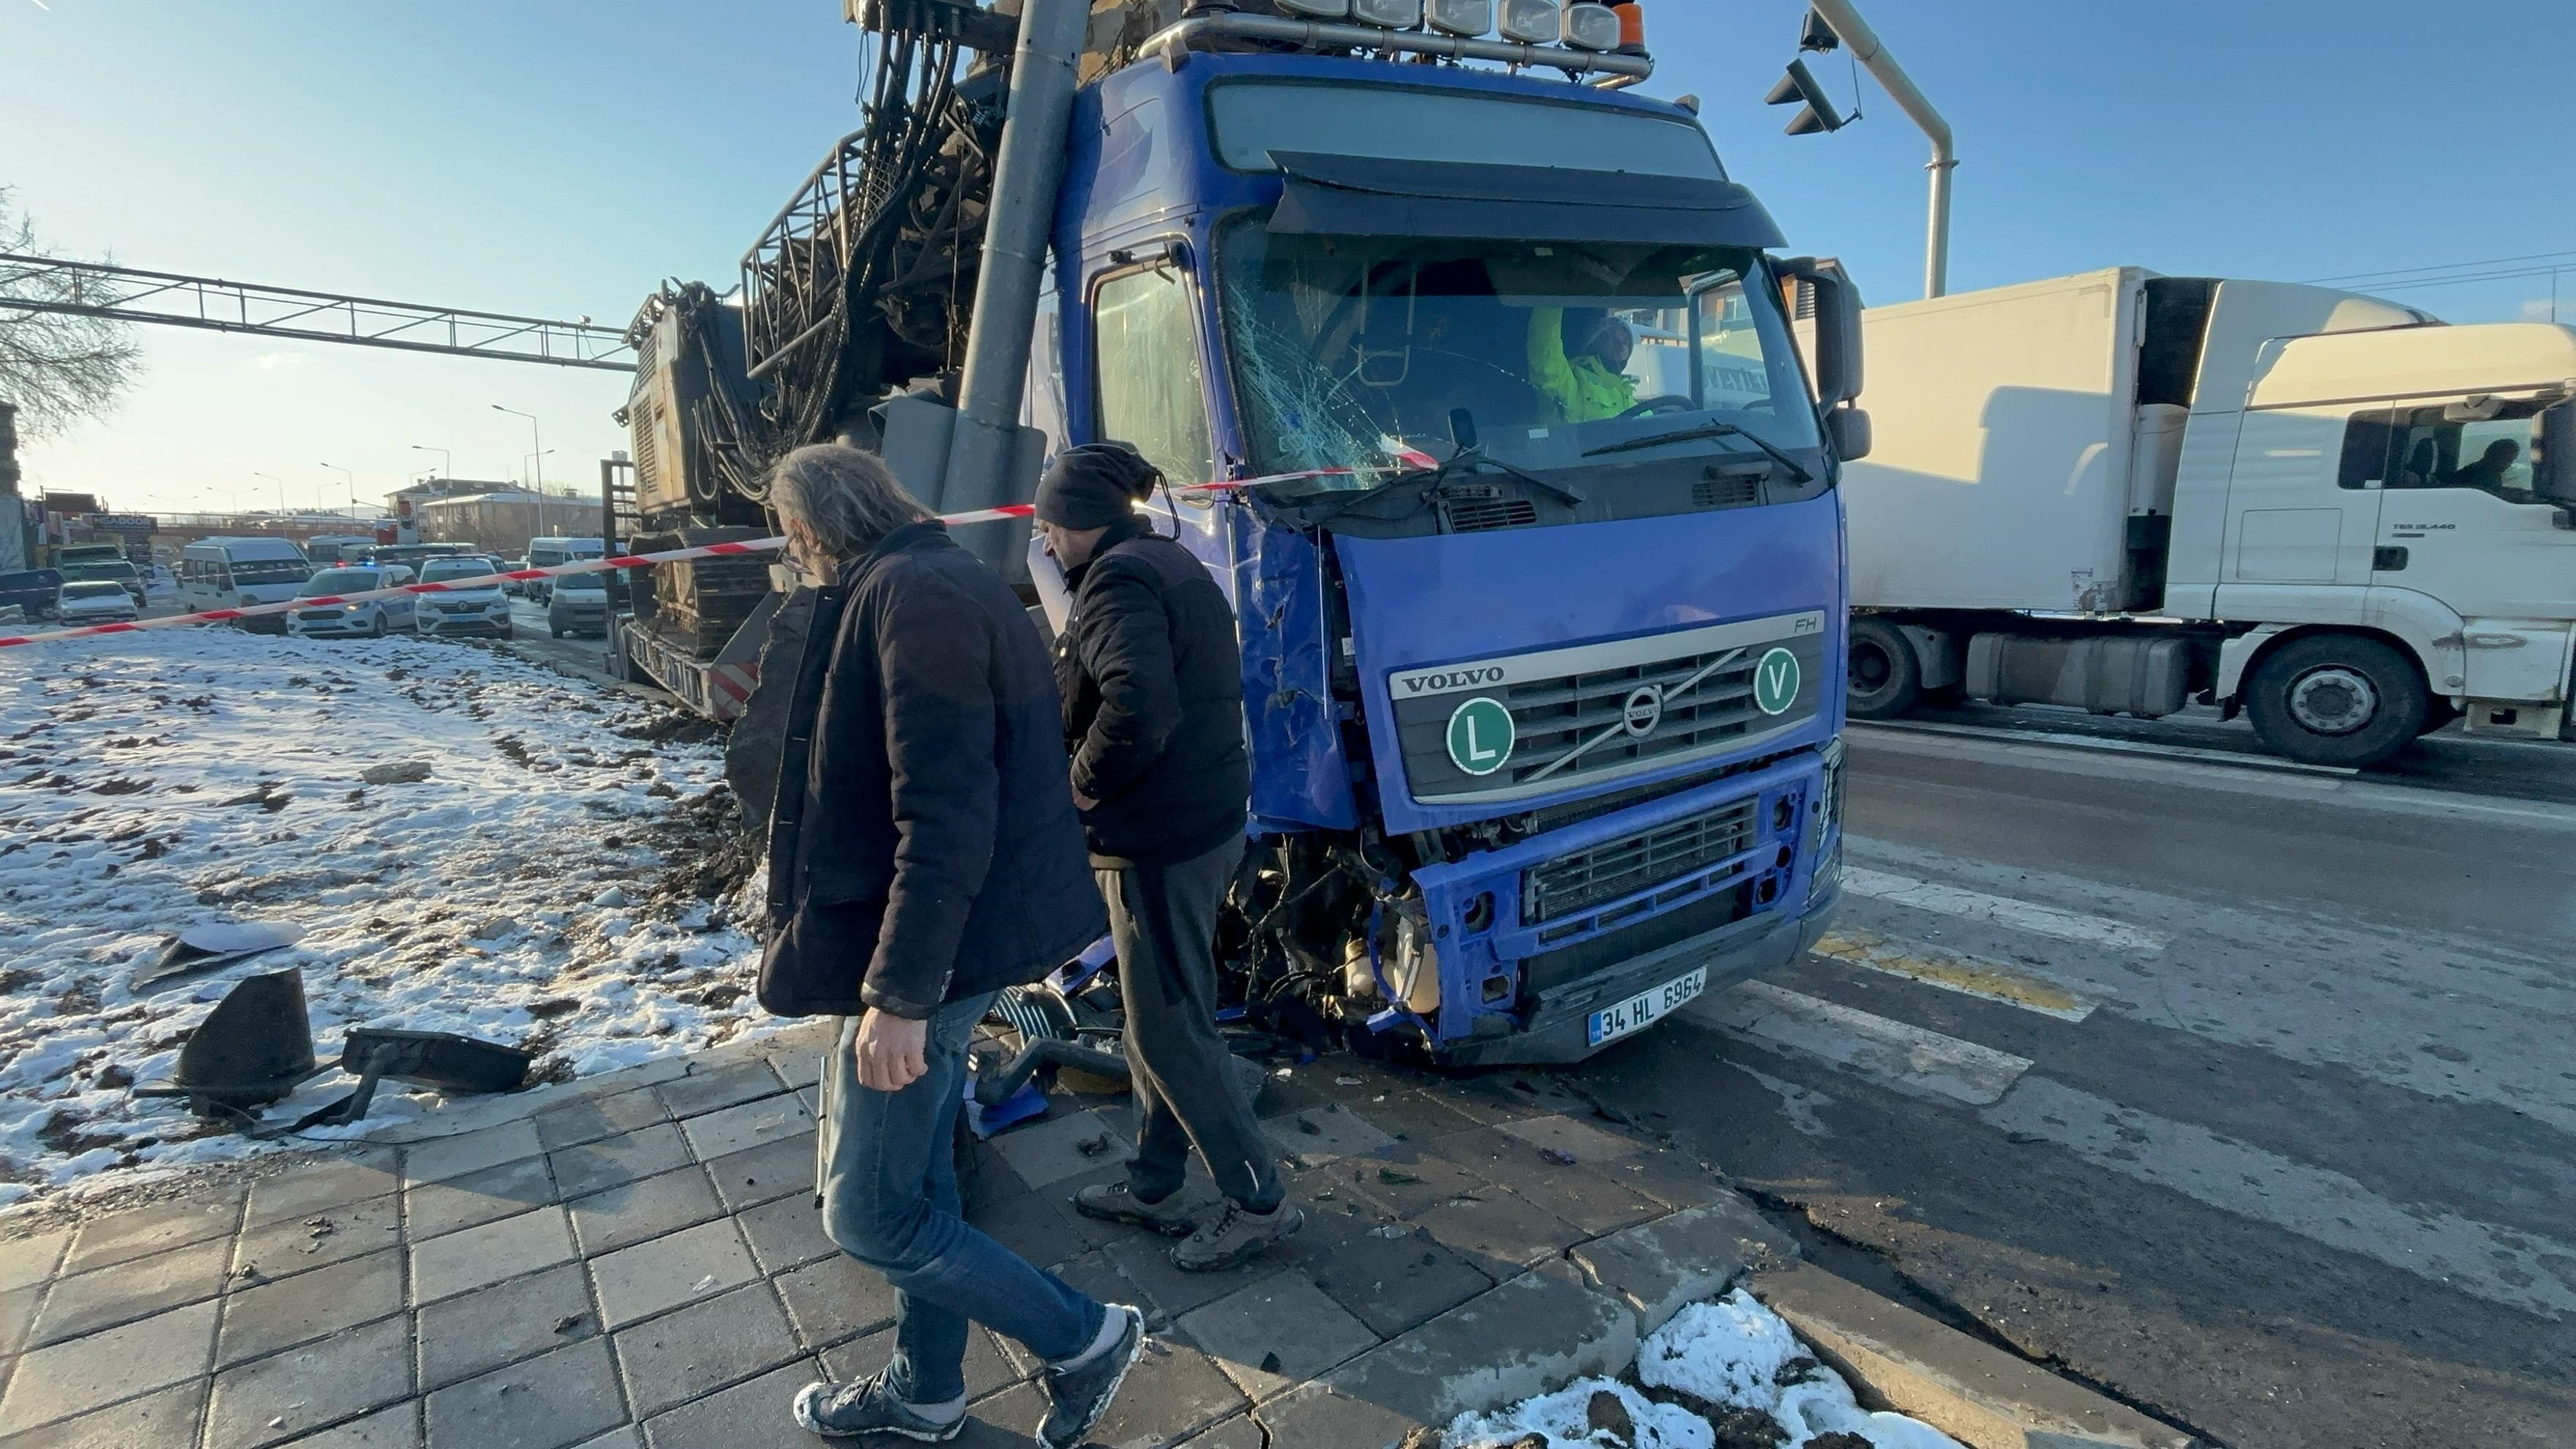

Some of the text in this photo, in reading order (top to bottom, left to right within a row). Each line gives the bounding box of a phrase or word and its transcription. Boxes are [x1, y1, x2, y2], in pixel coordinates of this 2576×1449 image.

[1794, 618, 1817, 633] FH
[1402, 667, 1505, 692] VOLVO
[1767, 663, 1786, 700] V
[1626, 706, 1660, 718] VOLVO
[1467, 716, 1496, 761] L
[1603, 973, 1701, 1036] 34 HL 6964
